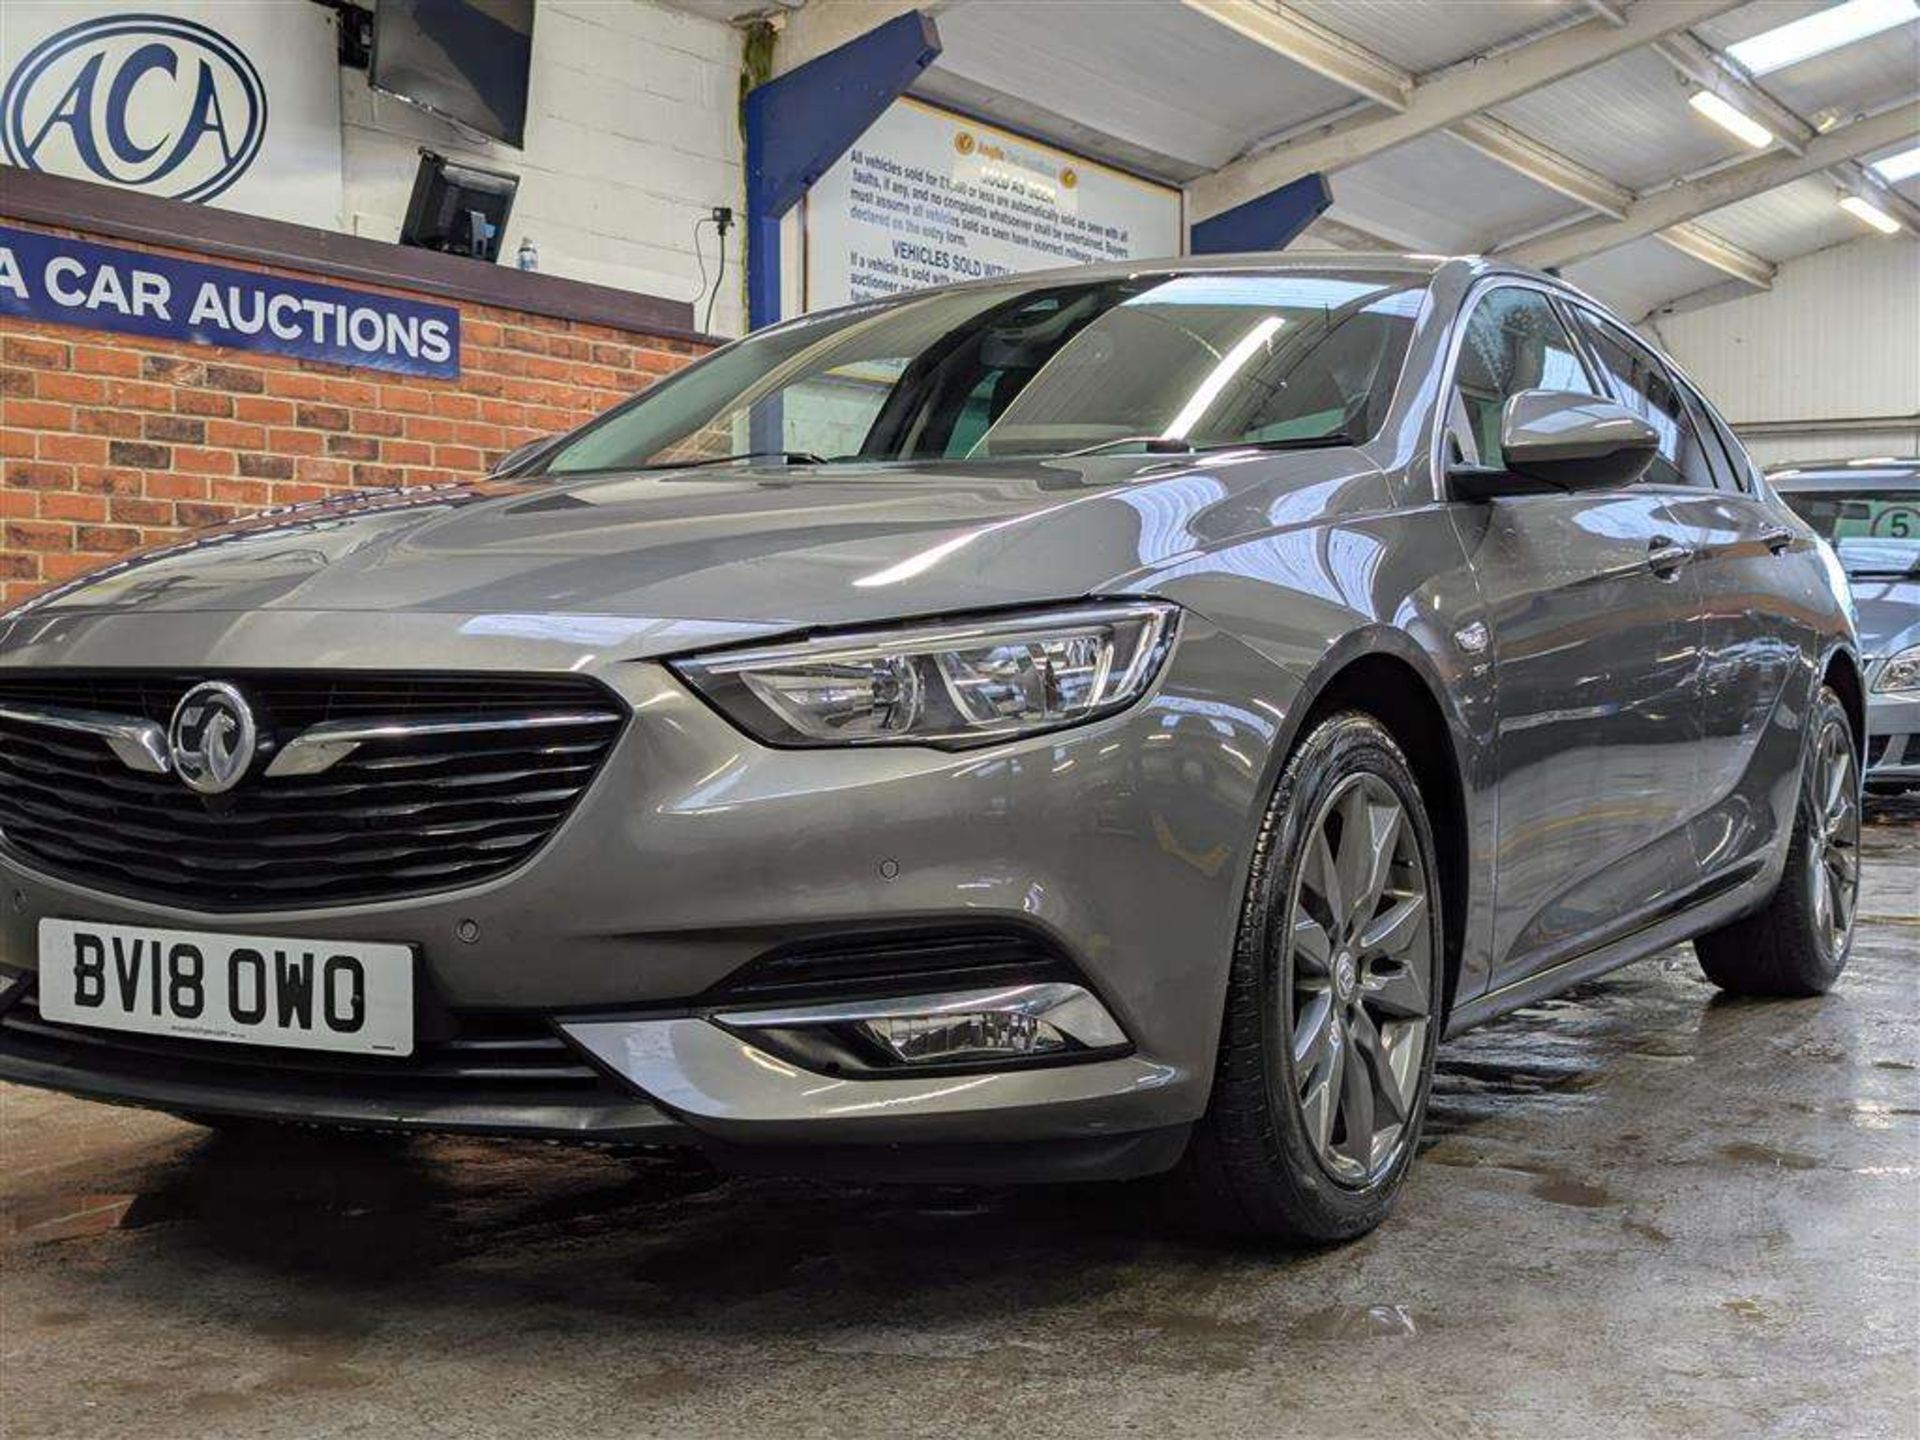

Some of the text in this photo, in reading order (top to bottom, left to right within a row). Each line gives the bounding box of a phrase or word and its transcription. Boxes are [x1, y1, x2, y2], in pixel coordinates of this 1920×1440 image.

[27, 43, 235, 185] ACA
[851, 149, 863, 163] All
[864, 155, 902, 176] vehicles
[904, 167, 924, 182] sold
[925, 171, 938, 185] for
[850, 188, 874, 203] must
[875, 196, 910, 215] assume
[925, 208, 960, 228] vehicles
[961, 218, 979, 233] sold
[980, 225, 990, 236] as
[991, 227, 1010, 240] seen
[912, 187, 929, 201] and
[930, 193, 941, 205] no
[850, 251, 858, 265] If
[860, 257, 865, 268] a
[867, 257, 899, 275] vehicle
[901, 263, 909, 278] is
[911, 268, 931, 283] sold
[892, 240, 951, 270] VEHICLES
[952, 254, 982, 277] SOLD
[850, 272, 899, 293] auctioneer
[0, 247, 451, 363] A CAR AUCTIONS
[1891, 512, 1909, 538] 5
[73, 931, 365, 1034] BV18 OWO
